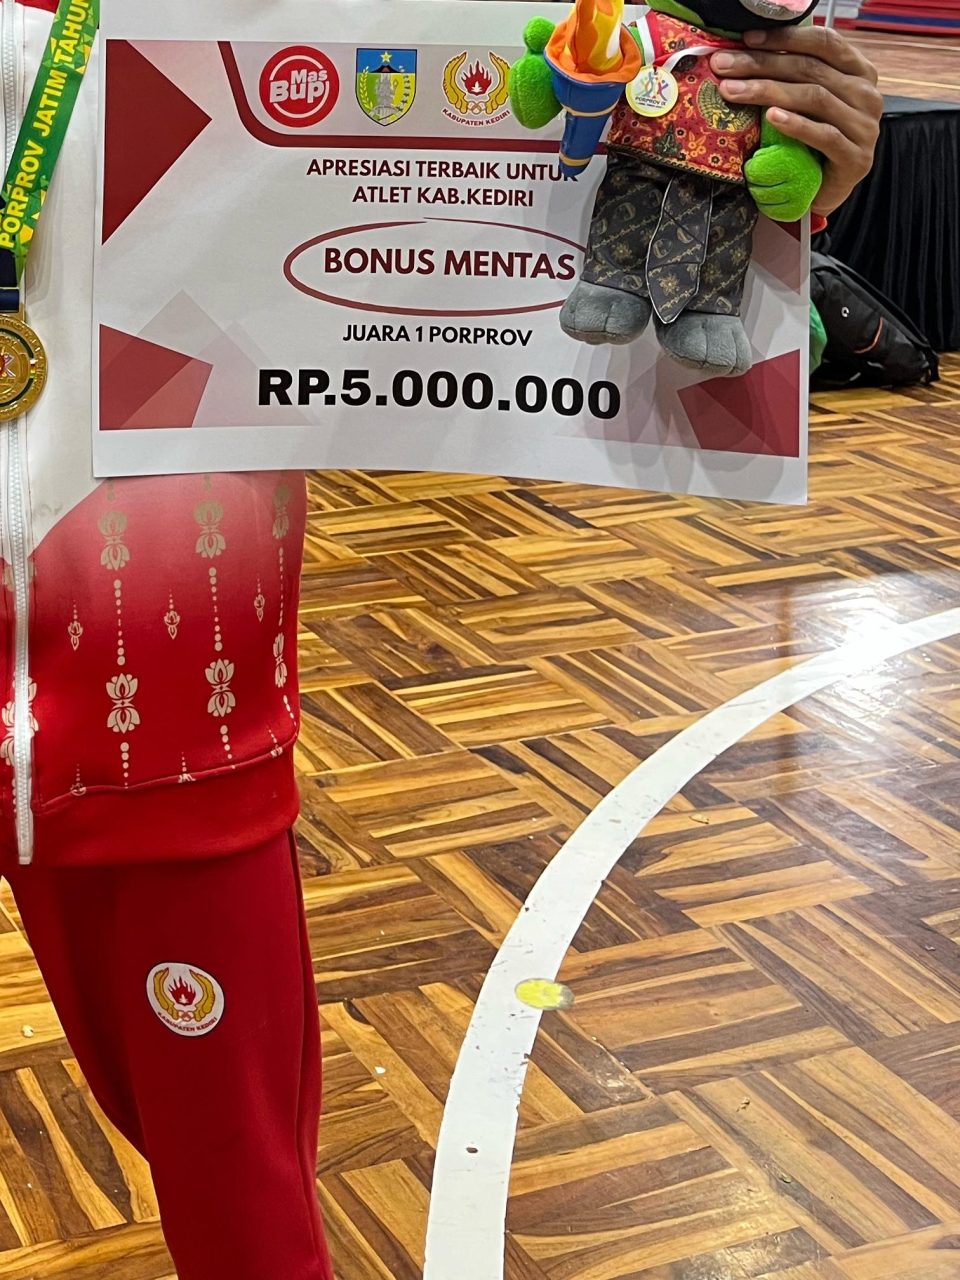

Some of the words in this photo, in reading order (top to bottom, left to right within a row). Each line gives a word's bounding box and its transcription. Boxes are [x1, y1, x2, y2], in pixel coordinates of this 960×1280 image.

[290, 68, 328, 85] Mas
[269, 79, 326, 104] Bup
[33, 69, 68, 137] JATIM
[442, 108, 484, 126] KABUPATEN
[485, 109, 510, 126] KEDIRI
[306, 158, 411, 177] APRESIASI
[416, 161, 501, 180] TERBAIK
[352, 186, 412, 204] ATLET
[417, 187, 534, 207] KAB.KEDIRI
[324, 248, 435, 275] BONUS
[444, 250, 576, 281] MENTAS
[343, 325, 410, 342] JUARA
[415, 326, 423, 342] 1
[430, 326, 533, 347] PORPROV
[258, 368, 621, 420] RP.5.000.000
